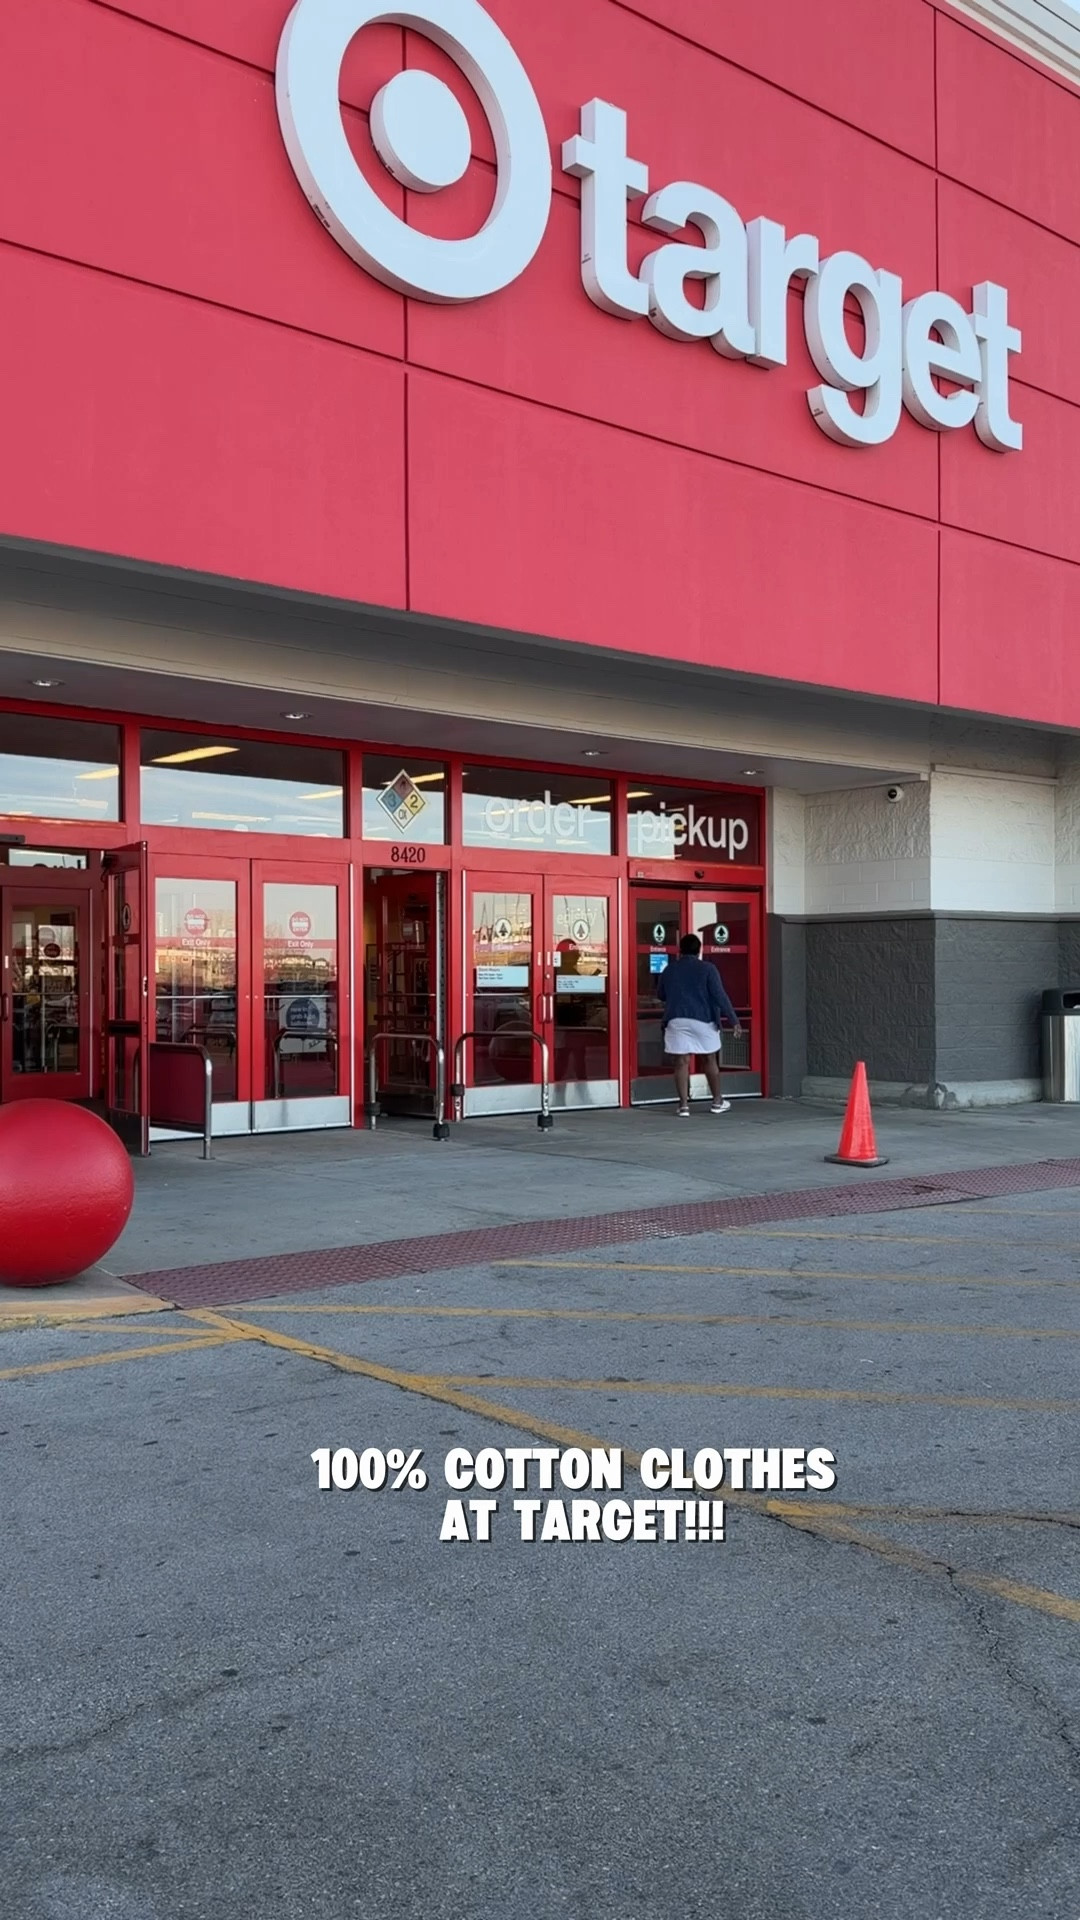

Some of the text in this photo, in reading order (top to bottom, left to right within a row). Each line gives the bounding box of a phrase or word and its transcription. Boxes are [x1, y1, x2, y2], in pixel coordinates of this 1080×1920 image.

[562, 97, 1022, 452] target
[410, 794, 418, 808] 2
[485, 790, 748, 860] order pickup
[391, 846, 426, 863] 8420
[182, 938, 211, 948] Exit Only
[288, 940, 314, 949] Exit Only
